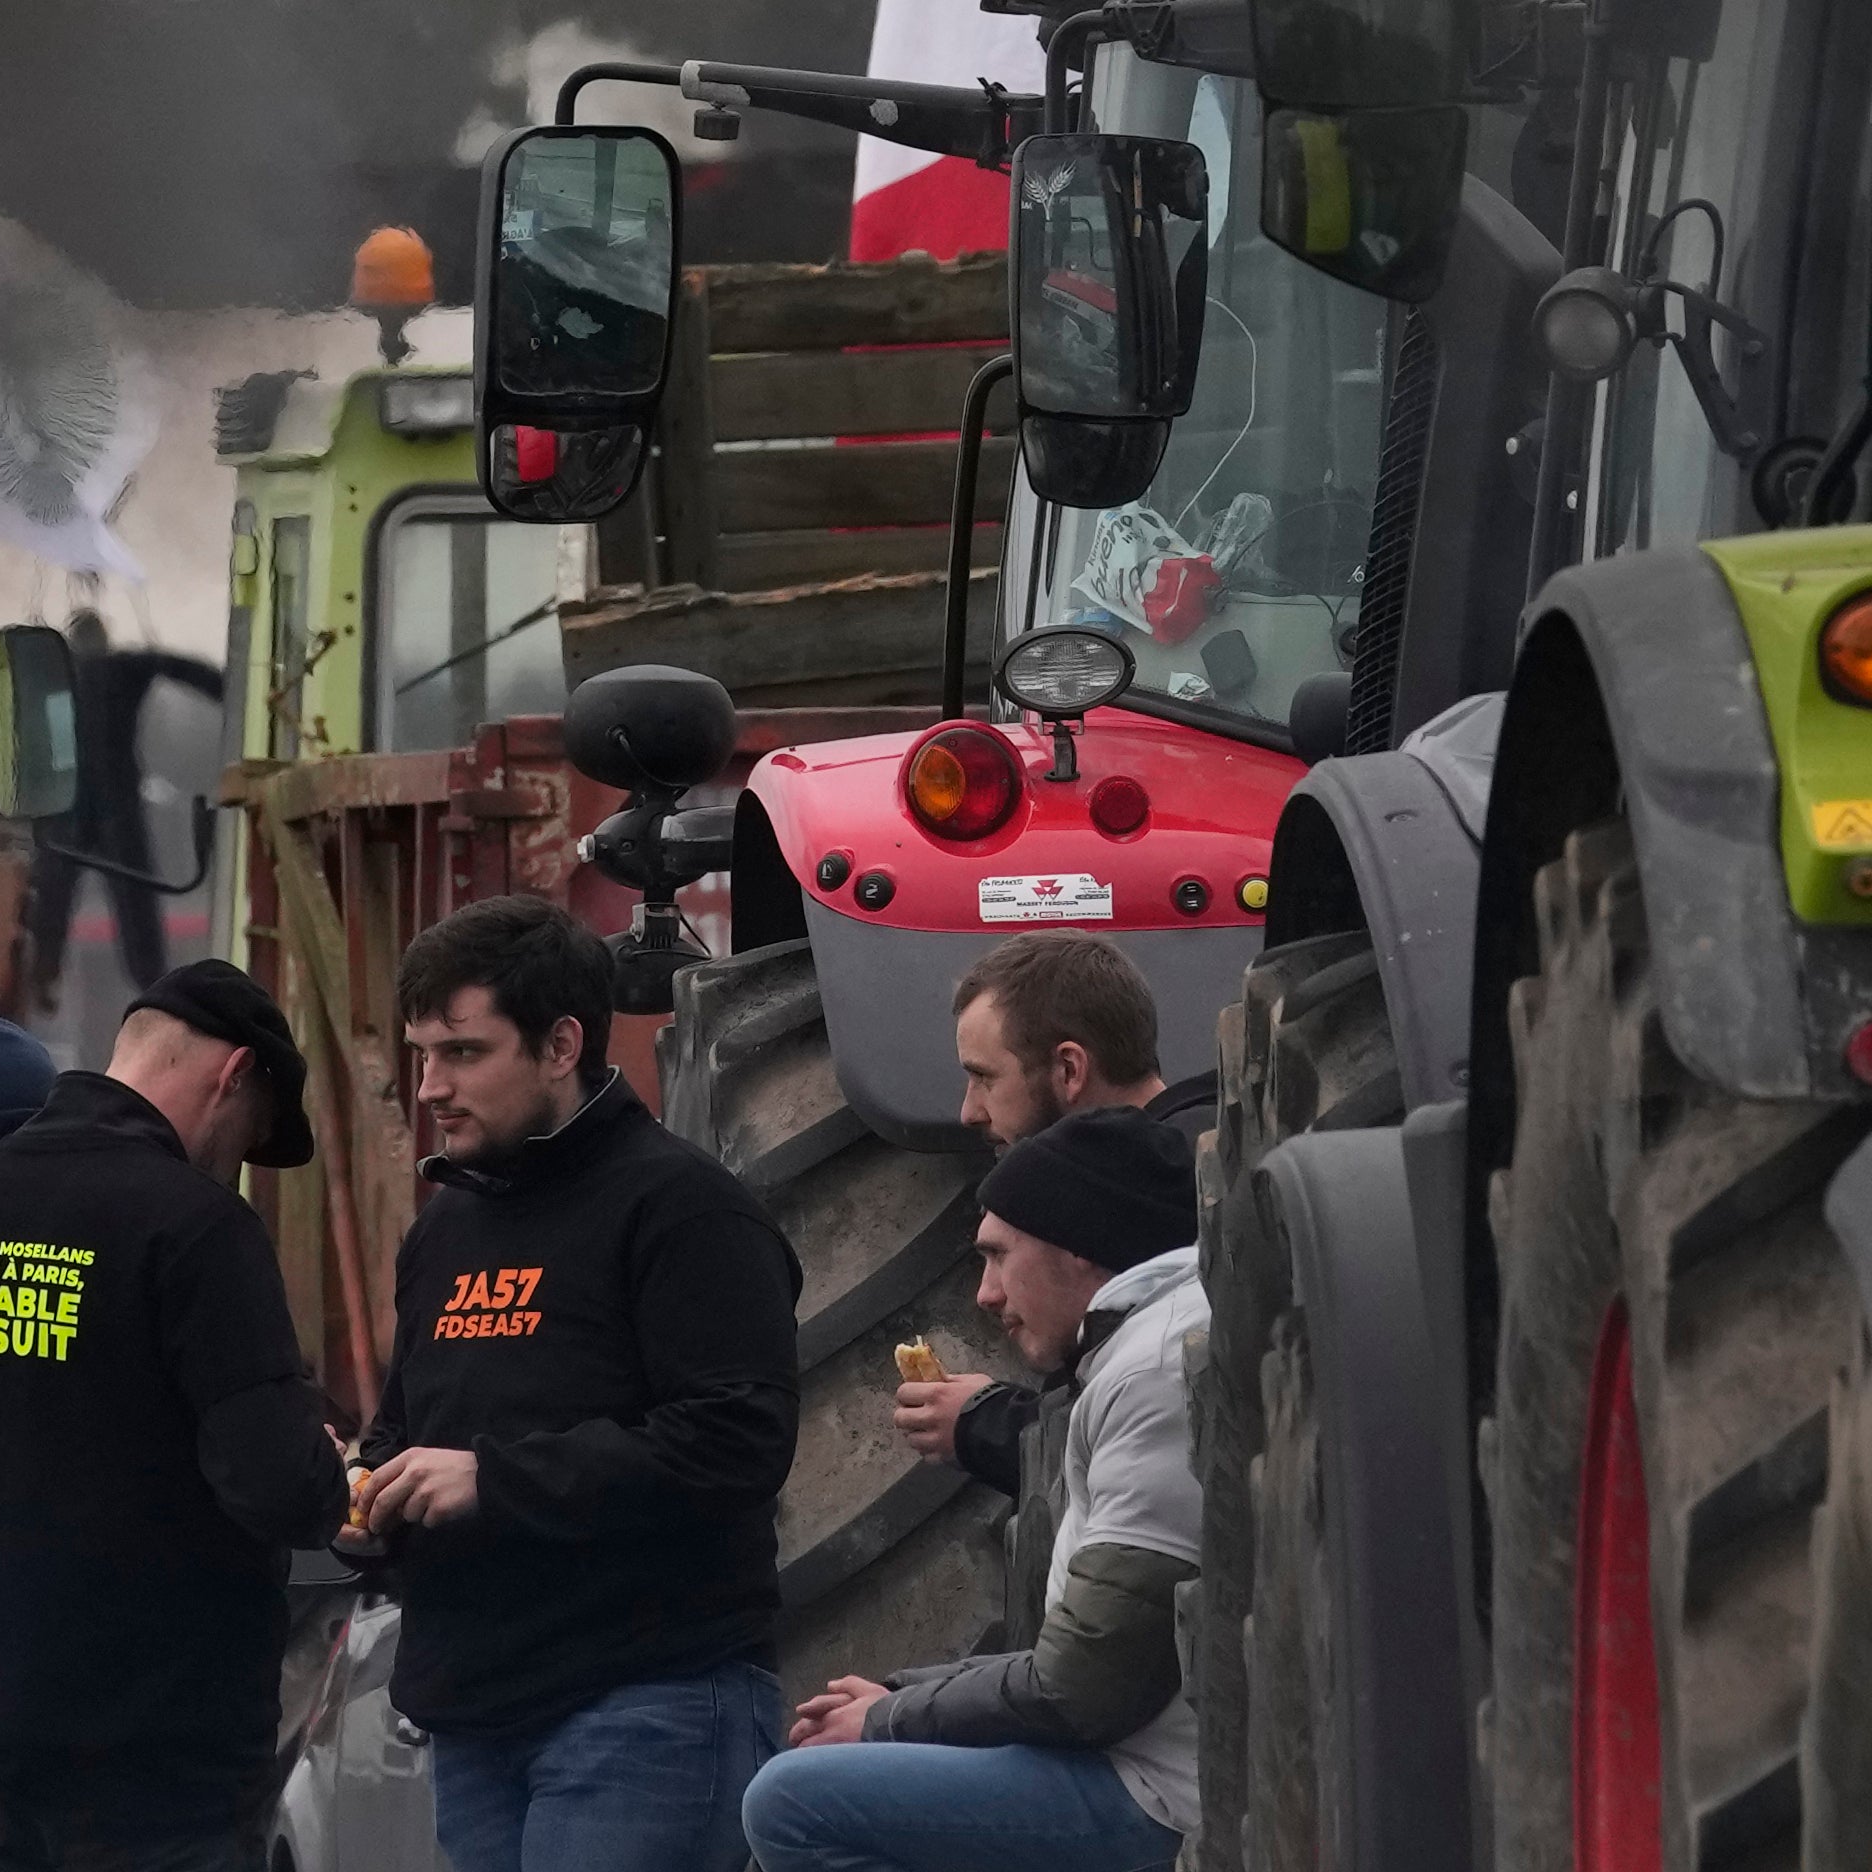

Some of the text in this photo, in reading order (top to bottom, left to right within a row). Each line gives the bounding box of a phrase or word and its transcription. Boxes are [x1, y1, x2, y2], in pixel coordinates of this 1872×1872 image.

[1090, 514, 1134, 601] bueno
[1, 1257, 18, 1281] À
[21, 1263, 85, 1292] PARIS,
[444, 1267, 544, 1312] JA57
[433, 1311, 542, 1341] FDSEA57
